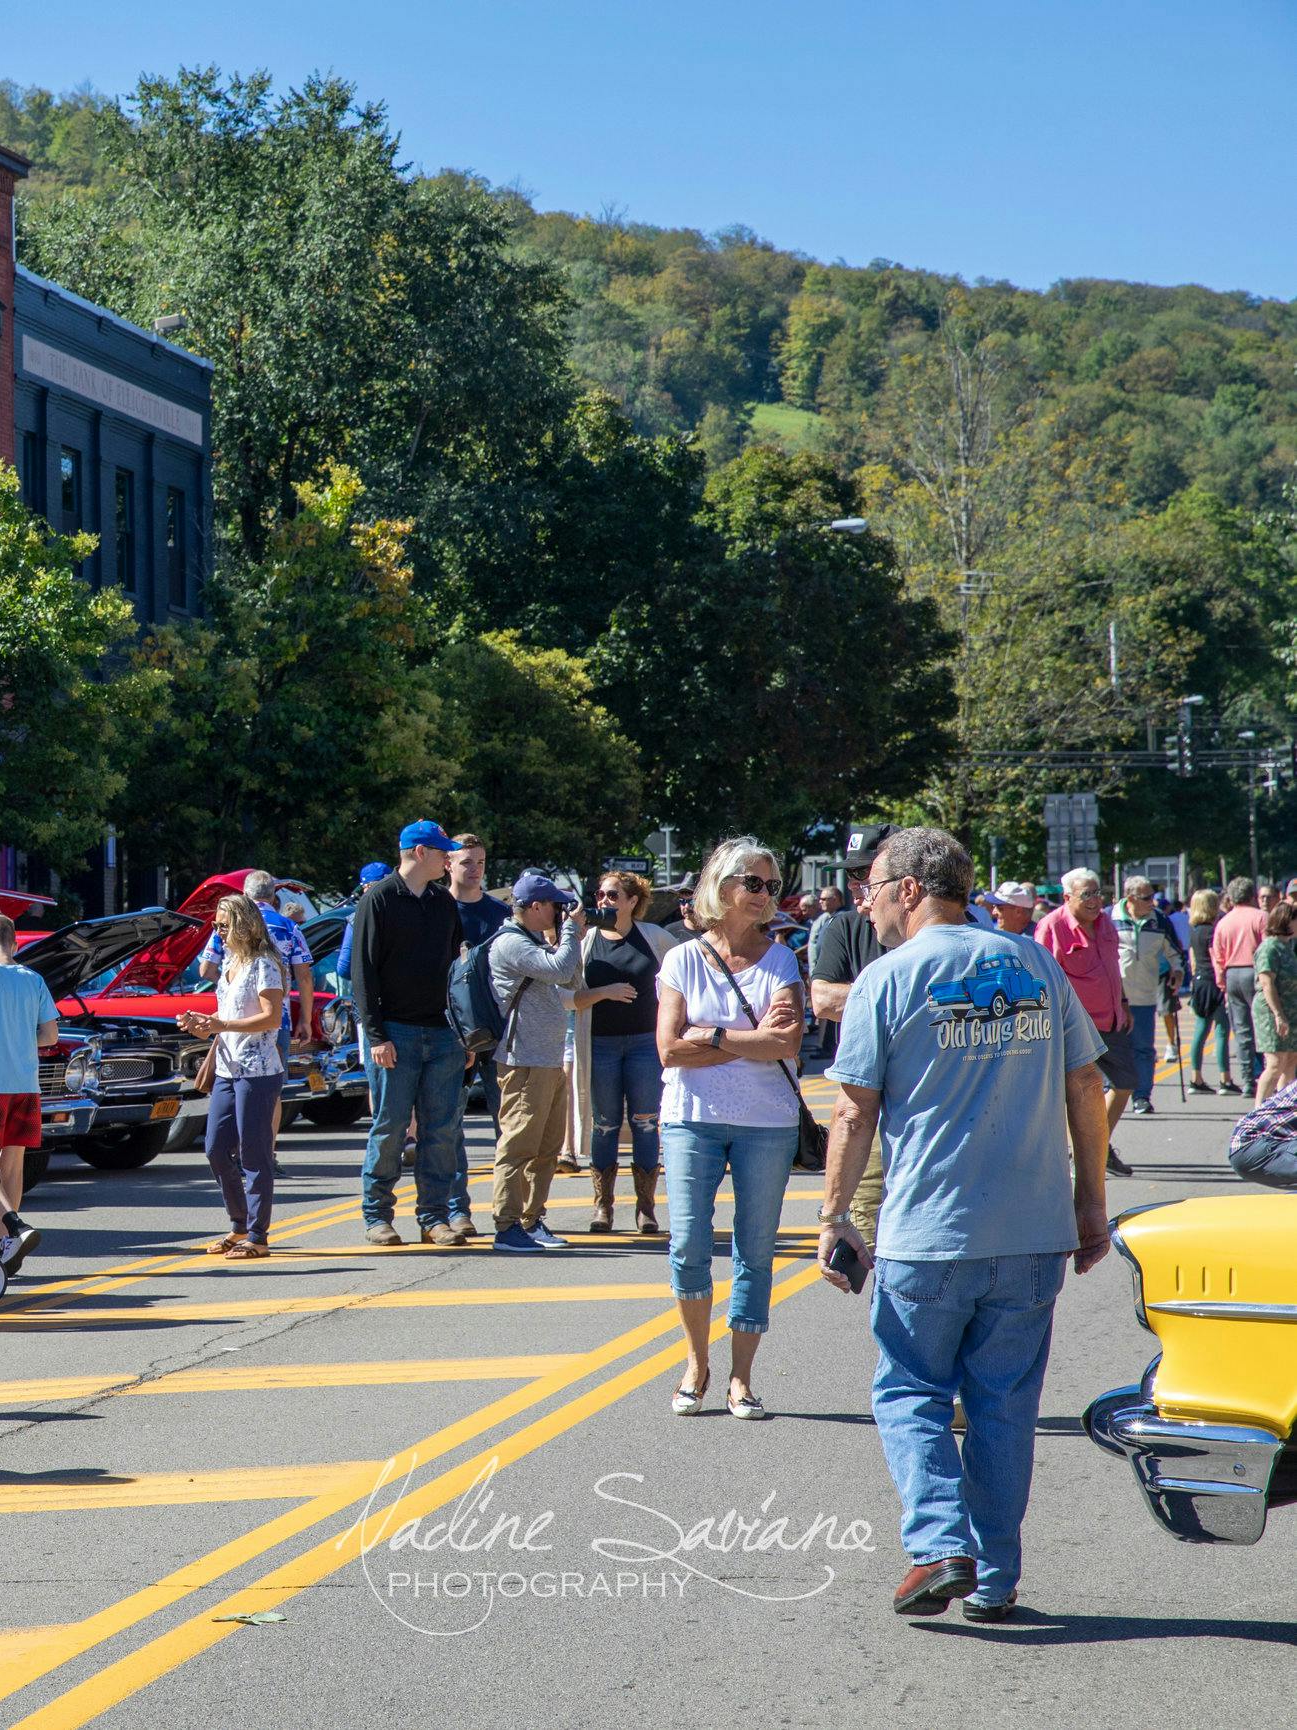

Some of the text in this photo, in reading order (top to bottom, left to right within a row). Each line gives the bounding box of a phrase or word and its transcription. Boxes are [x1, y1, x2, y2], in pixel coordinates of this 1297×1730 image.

[73, 364, 97, 396] BANK
[101, 377, 113, 403] OF
[937, 1011, 1051, 1051] Old Guys Rule
